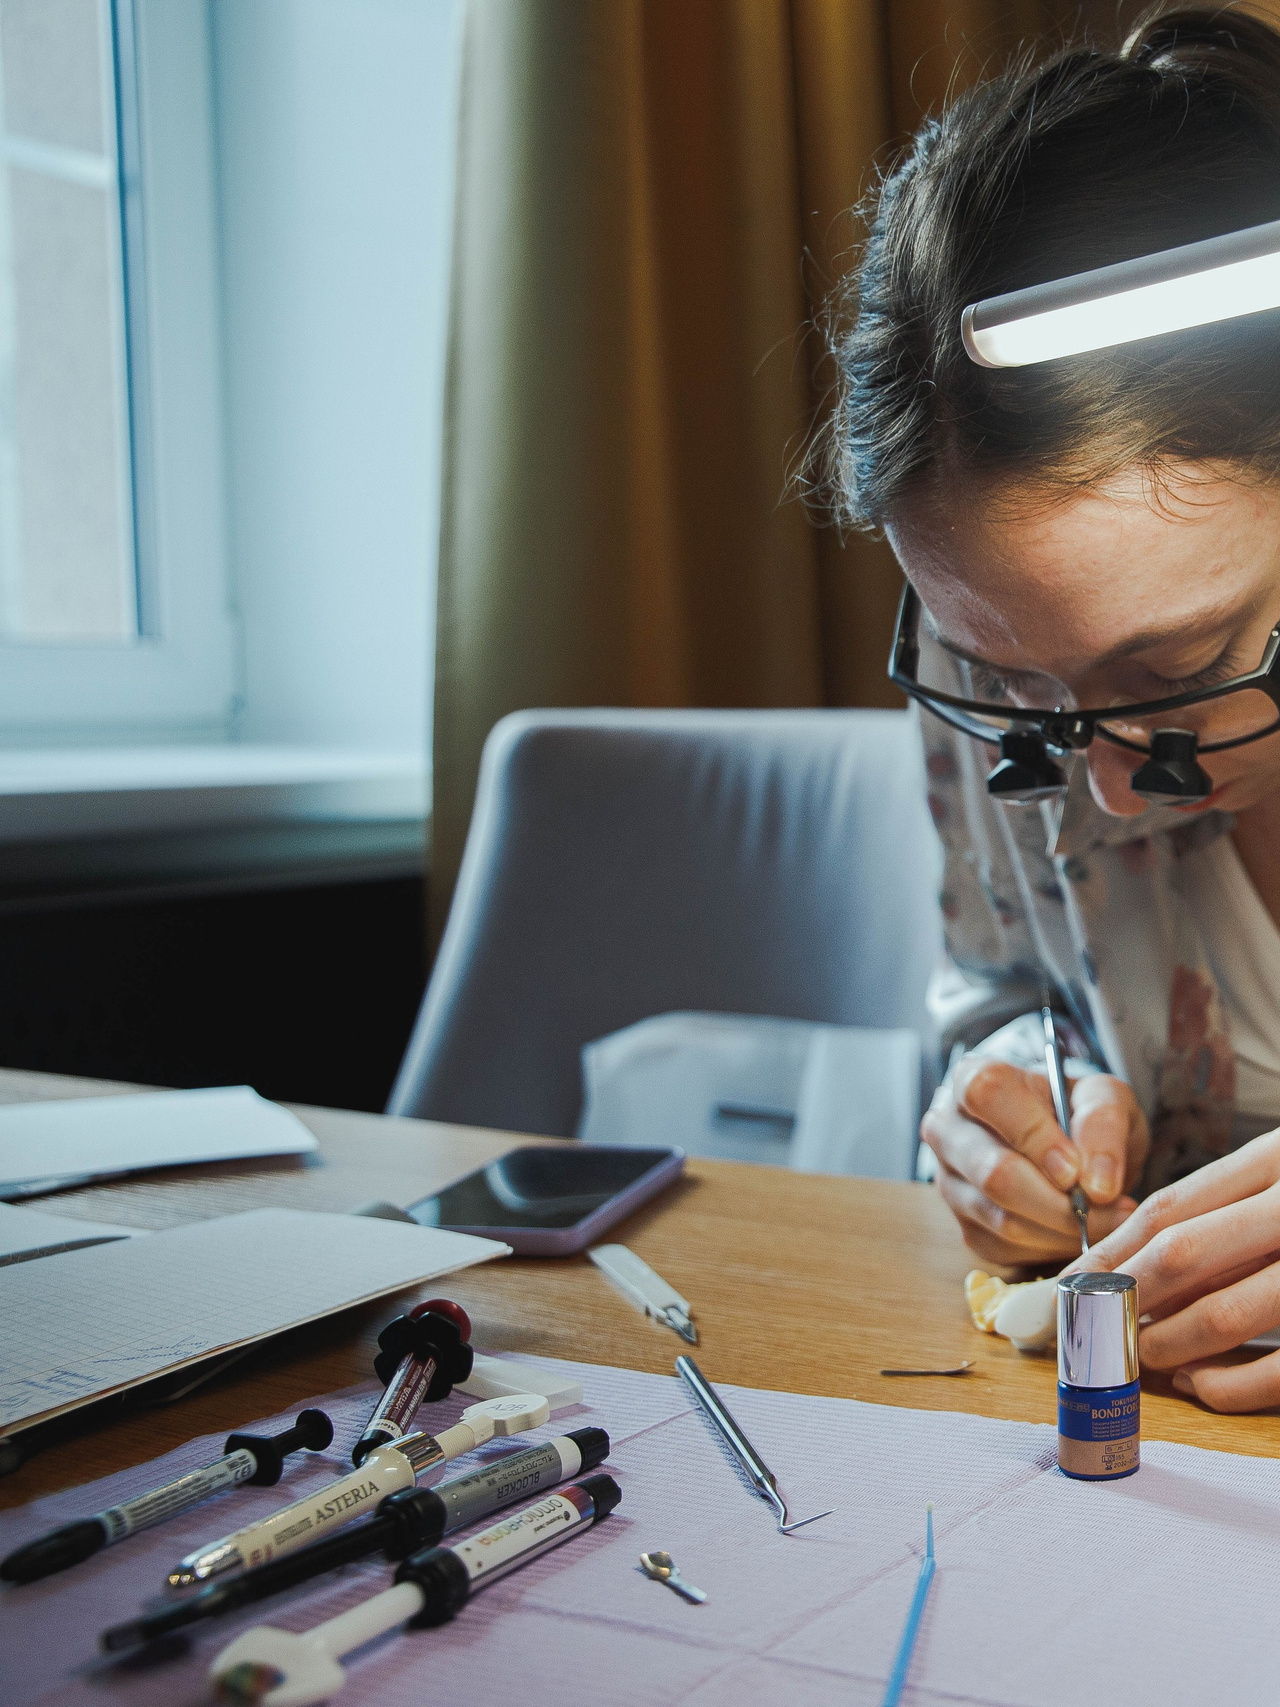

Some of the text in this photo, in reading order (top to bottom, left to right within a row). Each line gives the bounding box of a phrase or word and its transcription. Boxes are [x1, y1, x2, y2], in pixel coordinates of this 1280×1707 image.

[1092, 1407, 1121, 1419] BOND
[497, 1471, 540, 1499] BLOCKER
[315, 1480, 381, 1524] ASTERIA
